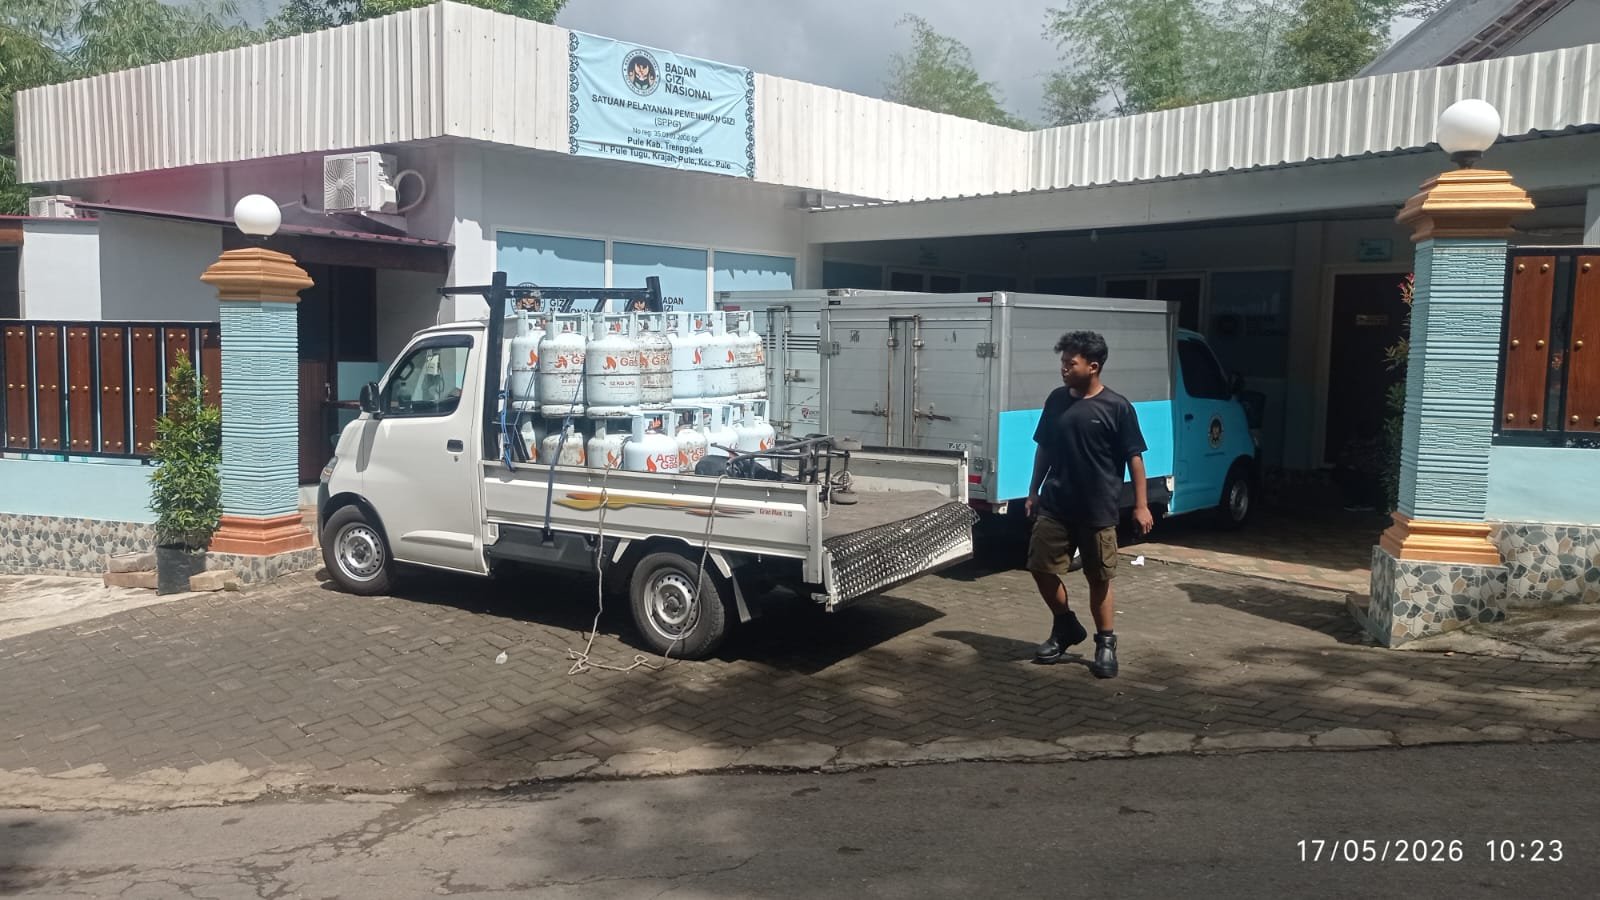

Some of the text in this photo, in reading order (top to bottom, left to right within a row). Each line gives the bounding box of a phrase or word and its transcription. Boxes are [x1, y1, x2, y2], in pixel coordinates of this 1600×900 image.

[665, 62, 697, 79] BADAN
[665, 73, 685, 86] GIZI
[665, 83, 713, 101] NASIONAL
[591, 94, 736, 126] SATUAN PELAYANAN PEMENUHAN GIZI
[655, 117, 682, 130] (SPPG)
[598, 143, 609, 153] Jl.
[610, 145, 628, 155] Pule
[627, 136, 704, 155] Pule Kab. Trenggalek
[662, 296, 684, 306] ADAN
